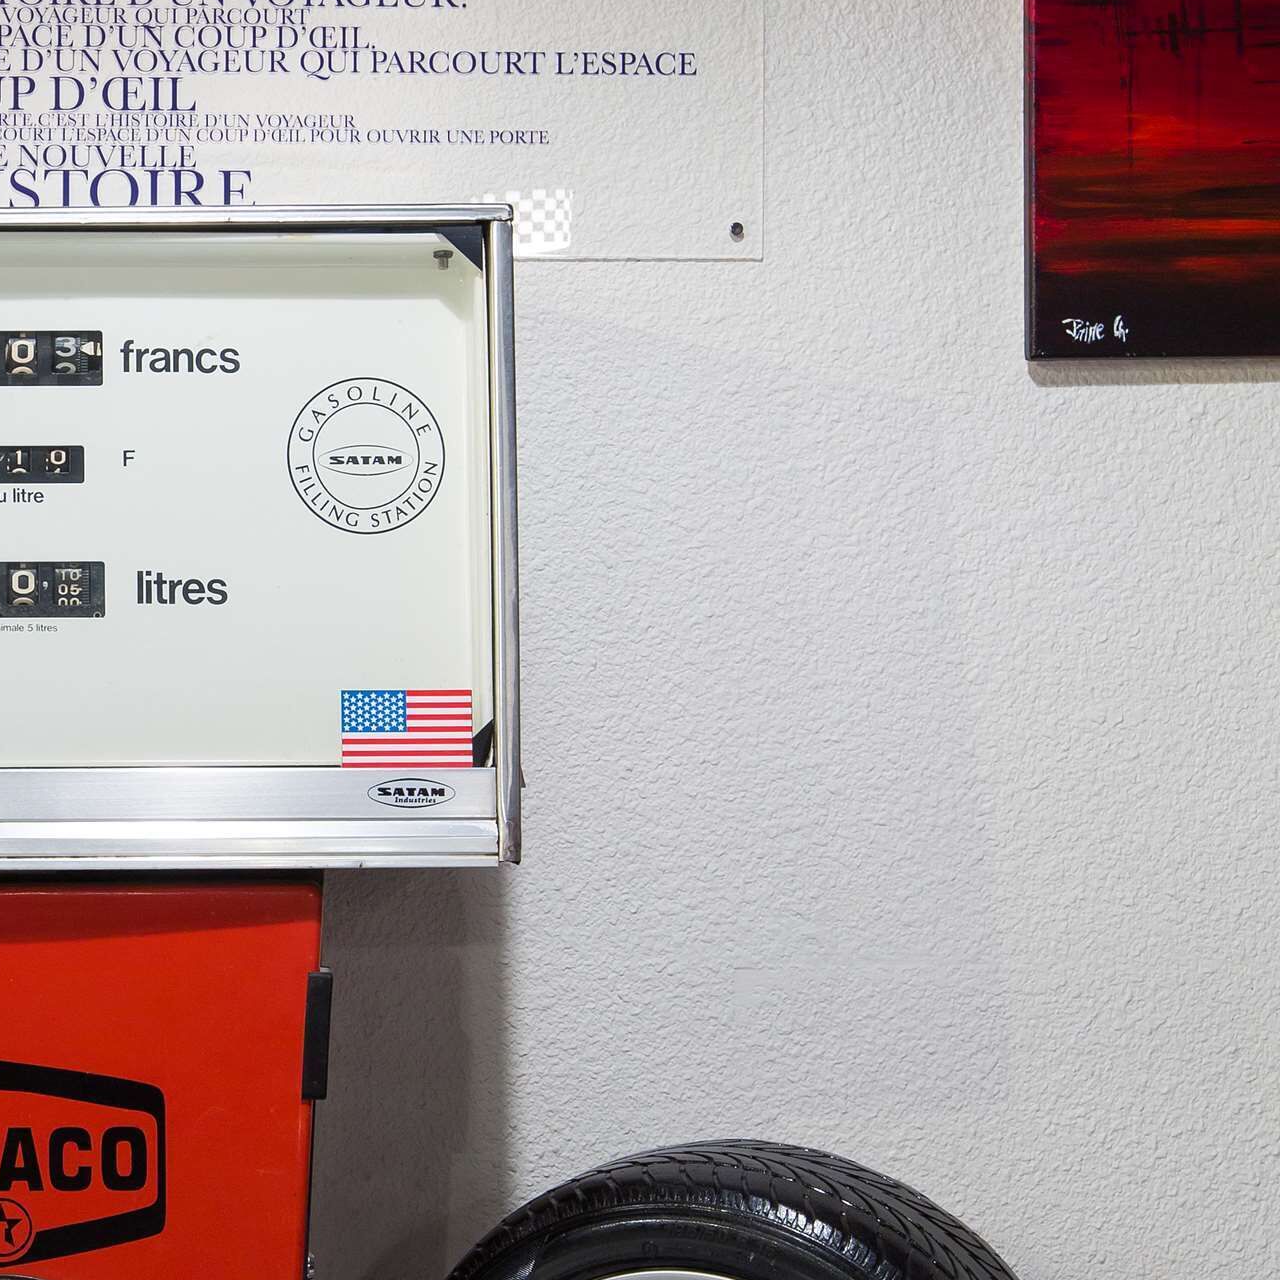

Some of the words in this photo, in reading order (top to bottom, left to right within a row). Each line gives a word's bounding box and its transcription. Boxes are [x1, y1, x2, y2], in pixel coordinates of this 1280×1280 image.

[4, 7, 126, 25] VOYAGEUR
[135, 7, 178, 29] QUI
[185, 7, 311, 26] PARCOURT
[84, 25, 162, 48] D'UN
[174, 25, 266, 49] COUP
[277, 26, 376, 50] D'ŒIL.
[21, 49, 101, 73] D'UN
[113, 50, 287, 74] VOYAGEUR
[299, 51, 360, 81] QUI
[371, 51, 545, 76] PARCOURT
[556, 52, 698, 77] L'ESPACE
[50, 76, 197, 112] D'ŒIL
[96, 114, 199, 128] L'HISTOIRE
[205, 114, 250, 128] D'UN
[257, 114, 355, 128] VOYAGEUR
[61, 128, 141, 142] L'ESPACE
[146, 128, 192, 142] D'UN
[197, 128, 248, 143] COUP
[253, 128, 305, 144] D'ŒIL
[311, 129, 361, 144] POUR
[367, 129, 441, 144] OUVRIR
[447, 130, 485, 144] UNE
[489, 130, 549, 145] PORTE
[18, 145, 197, 168] NOUVELLE
[120, 339, 241, 375] francs
[298, 386, 432, 442] GASOLINE
[123, 450, 136, 467] F
[329, 455, 402, 465] SATAM
[13, 488, 45, 503] litre
[295, 464, 359, 527] FILLING
[371, 461, 438, 527] STATION
[136, 570, 229, 605] litres
[27, 623, 34, 632] 5
[36, 623, 58, 632] litres
[377, 787, 446, 797] SATAM
[394, 796, 437, 804] Industries
